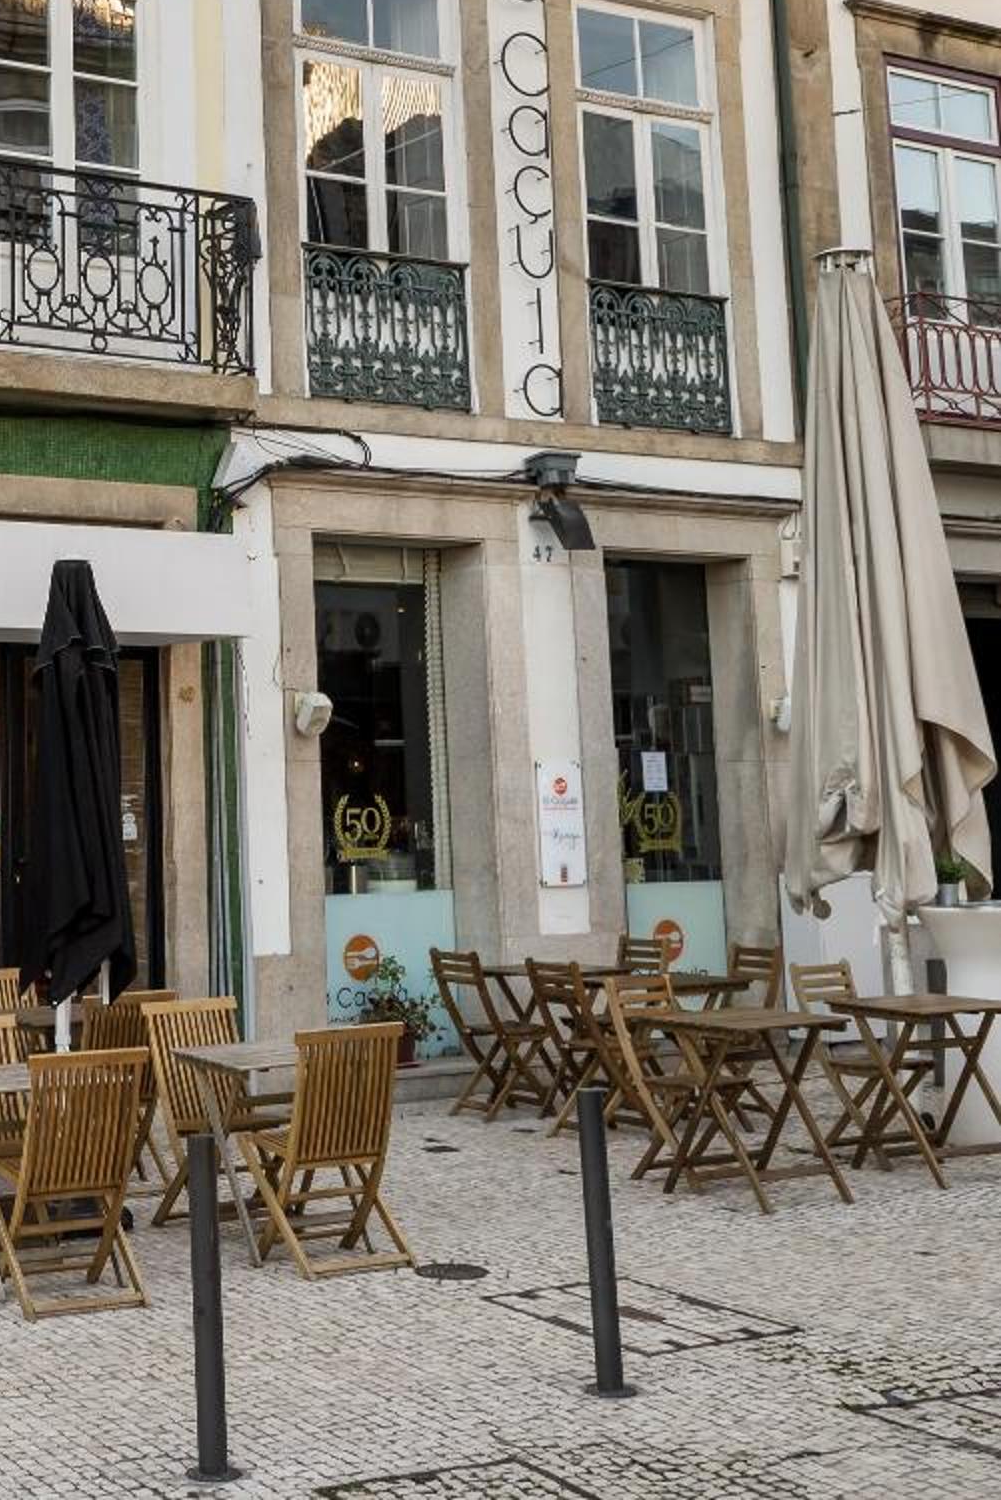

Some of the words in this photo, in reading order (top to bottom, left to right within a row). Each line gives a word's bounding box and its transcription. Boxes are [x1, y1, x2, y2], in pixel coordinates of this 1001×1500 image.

[532, 545, 553, 563] 47
[344, 807, 381, 842] 50
[644, 803, 674, 835] 50
